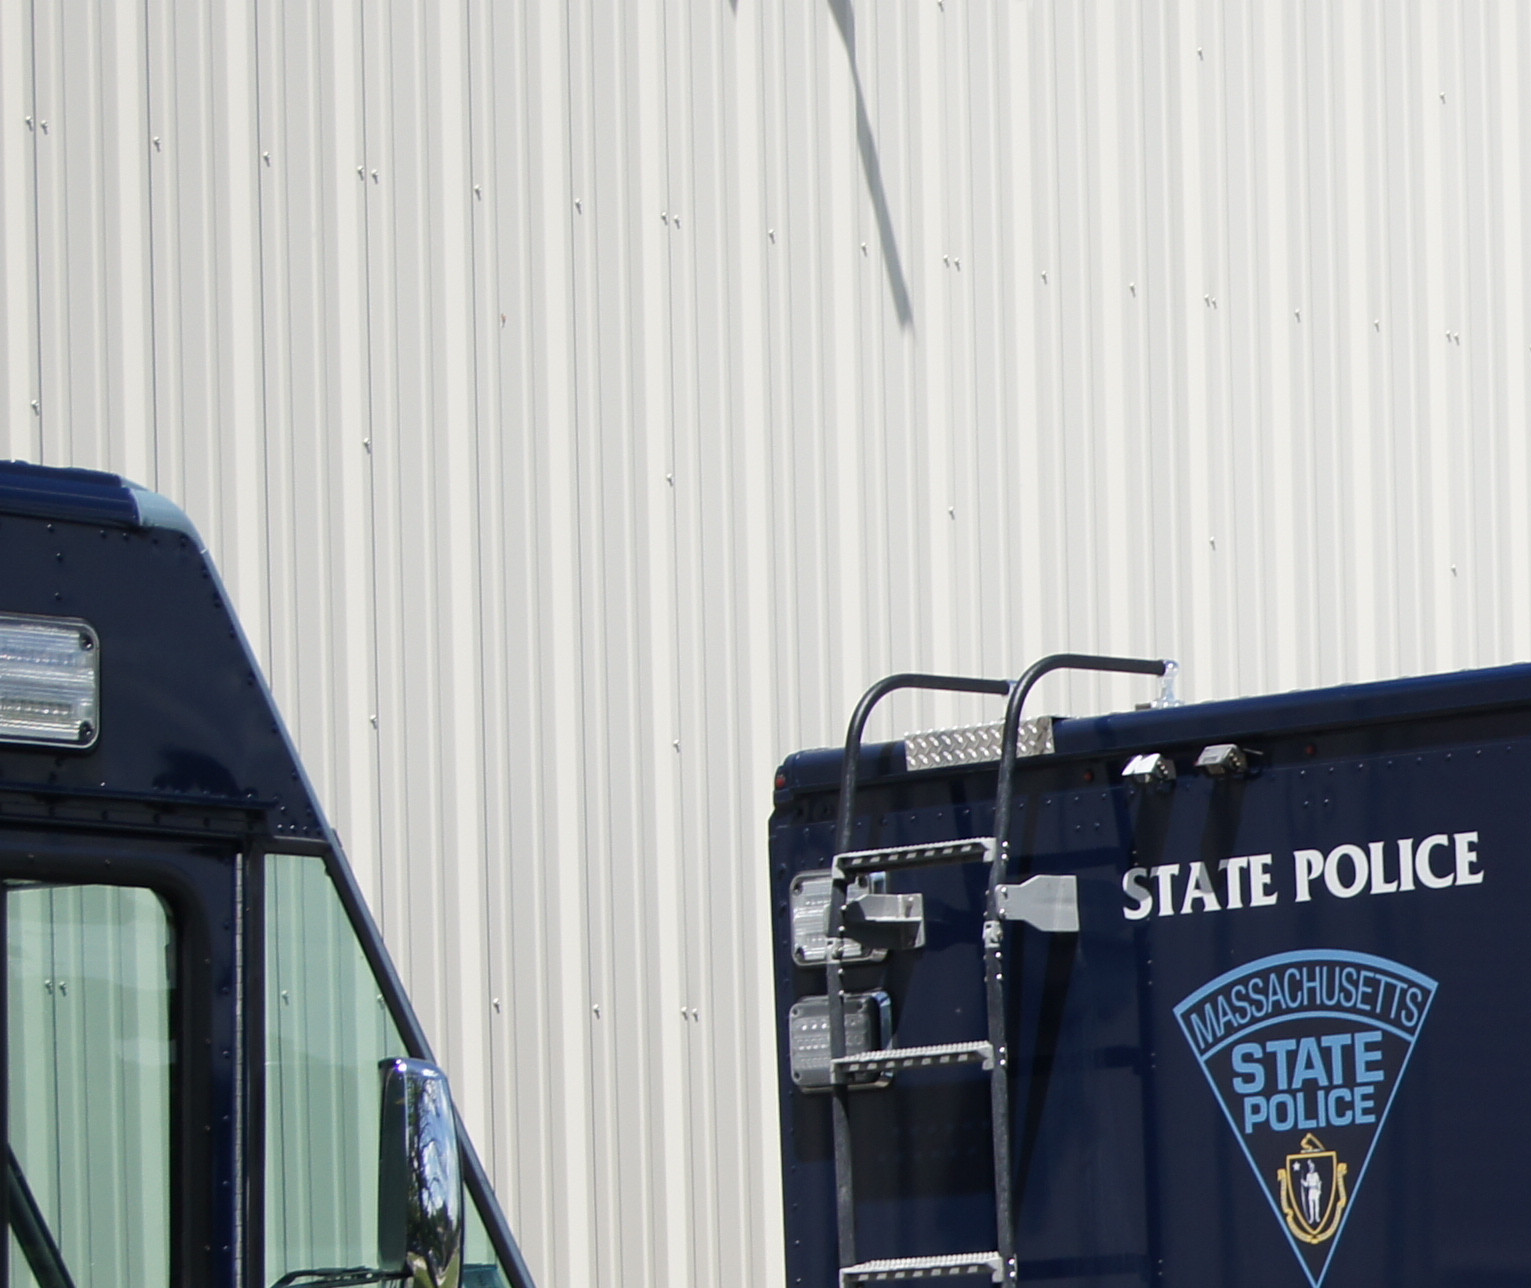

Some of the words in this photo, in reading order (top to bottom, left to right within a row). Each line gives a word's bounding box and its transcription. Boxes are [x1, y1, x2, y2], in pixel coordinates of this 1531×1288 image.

[1122, 853, 1278, 920] STATE
[1293, 831, 1485, 903] POLICE
[1190, 966, 1422, 1050] MASSACHUSETTS
[1232, 1030, 1385, 1094] STATE
[1243, 1086, 1376, 1134] POLICE
